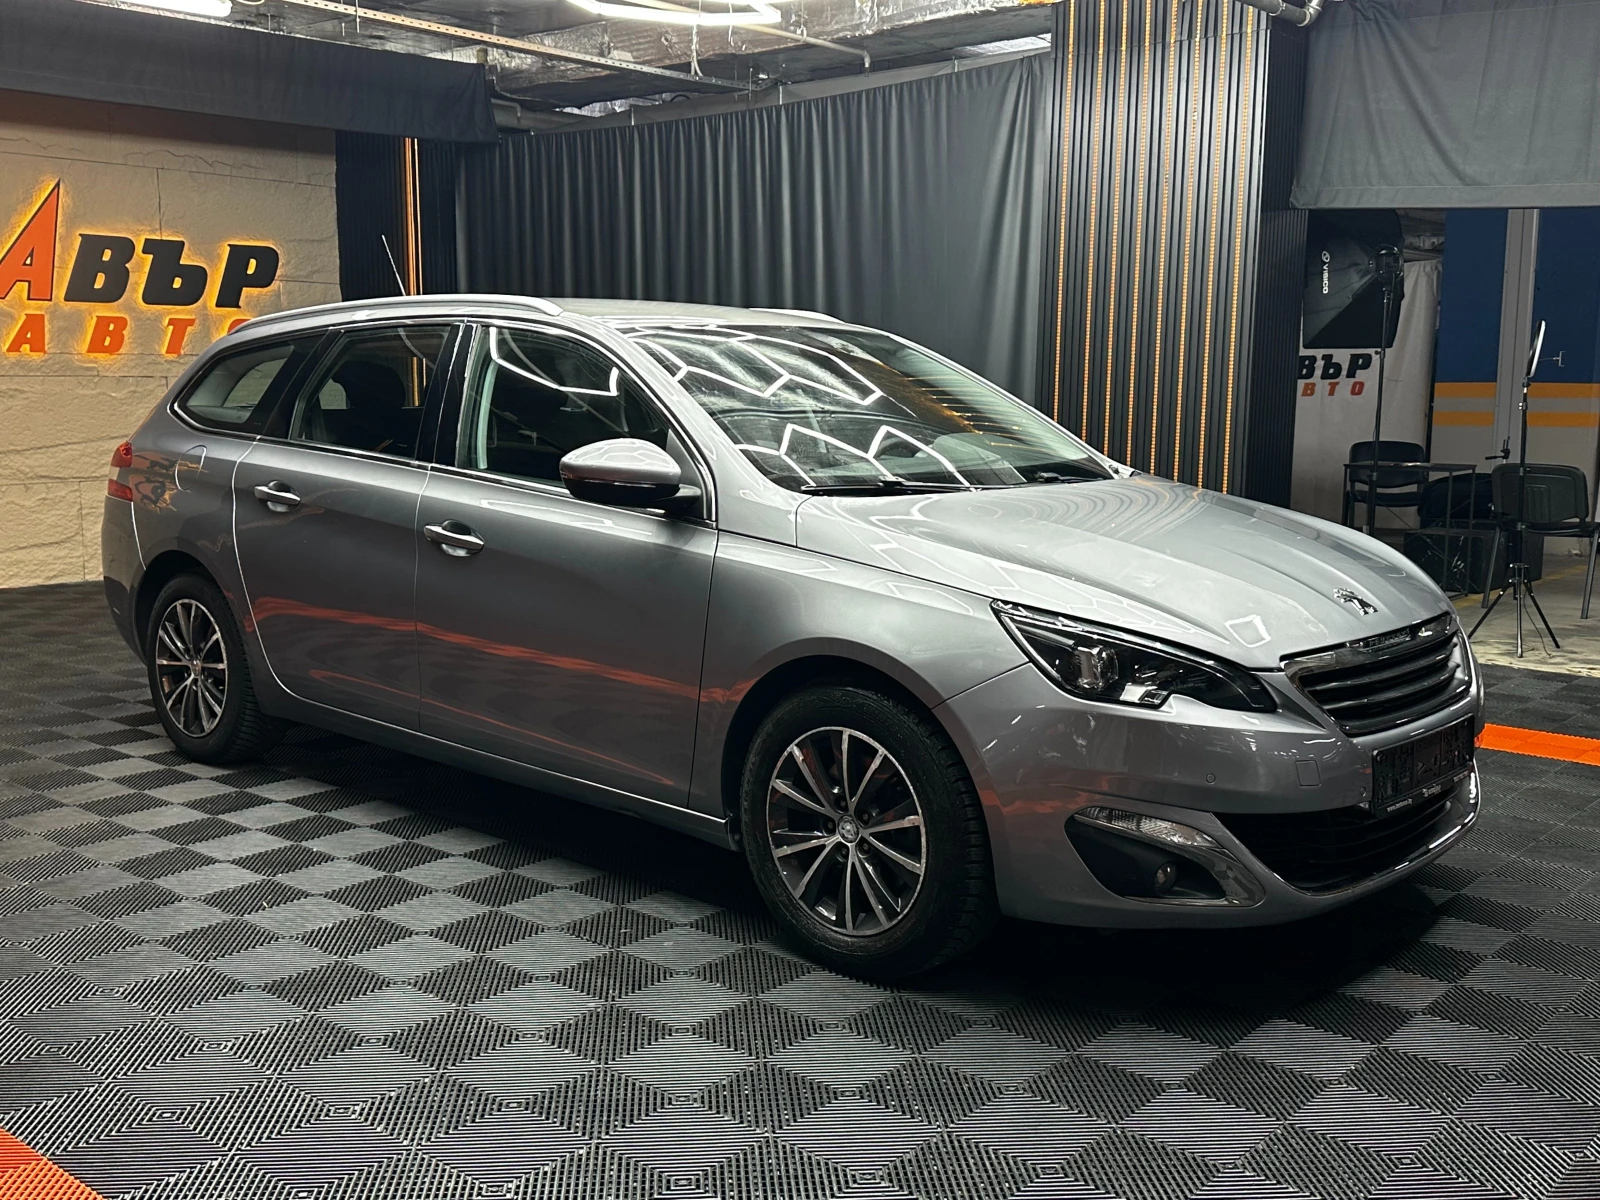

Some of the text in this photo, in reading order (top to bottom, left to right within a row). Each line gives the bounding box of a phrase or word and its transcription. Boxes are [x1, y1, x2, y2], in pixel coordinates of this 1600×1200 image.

[0, 178, 280, 308] АВЪР
[1297, 354, 1372, 380] ВЪР
[1301, 382, 1365, 396] ВТО
